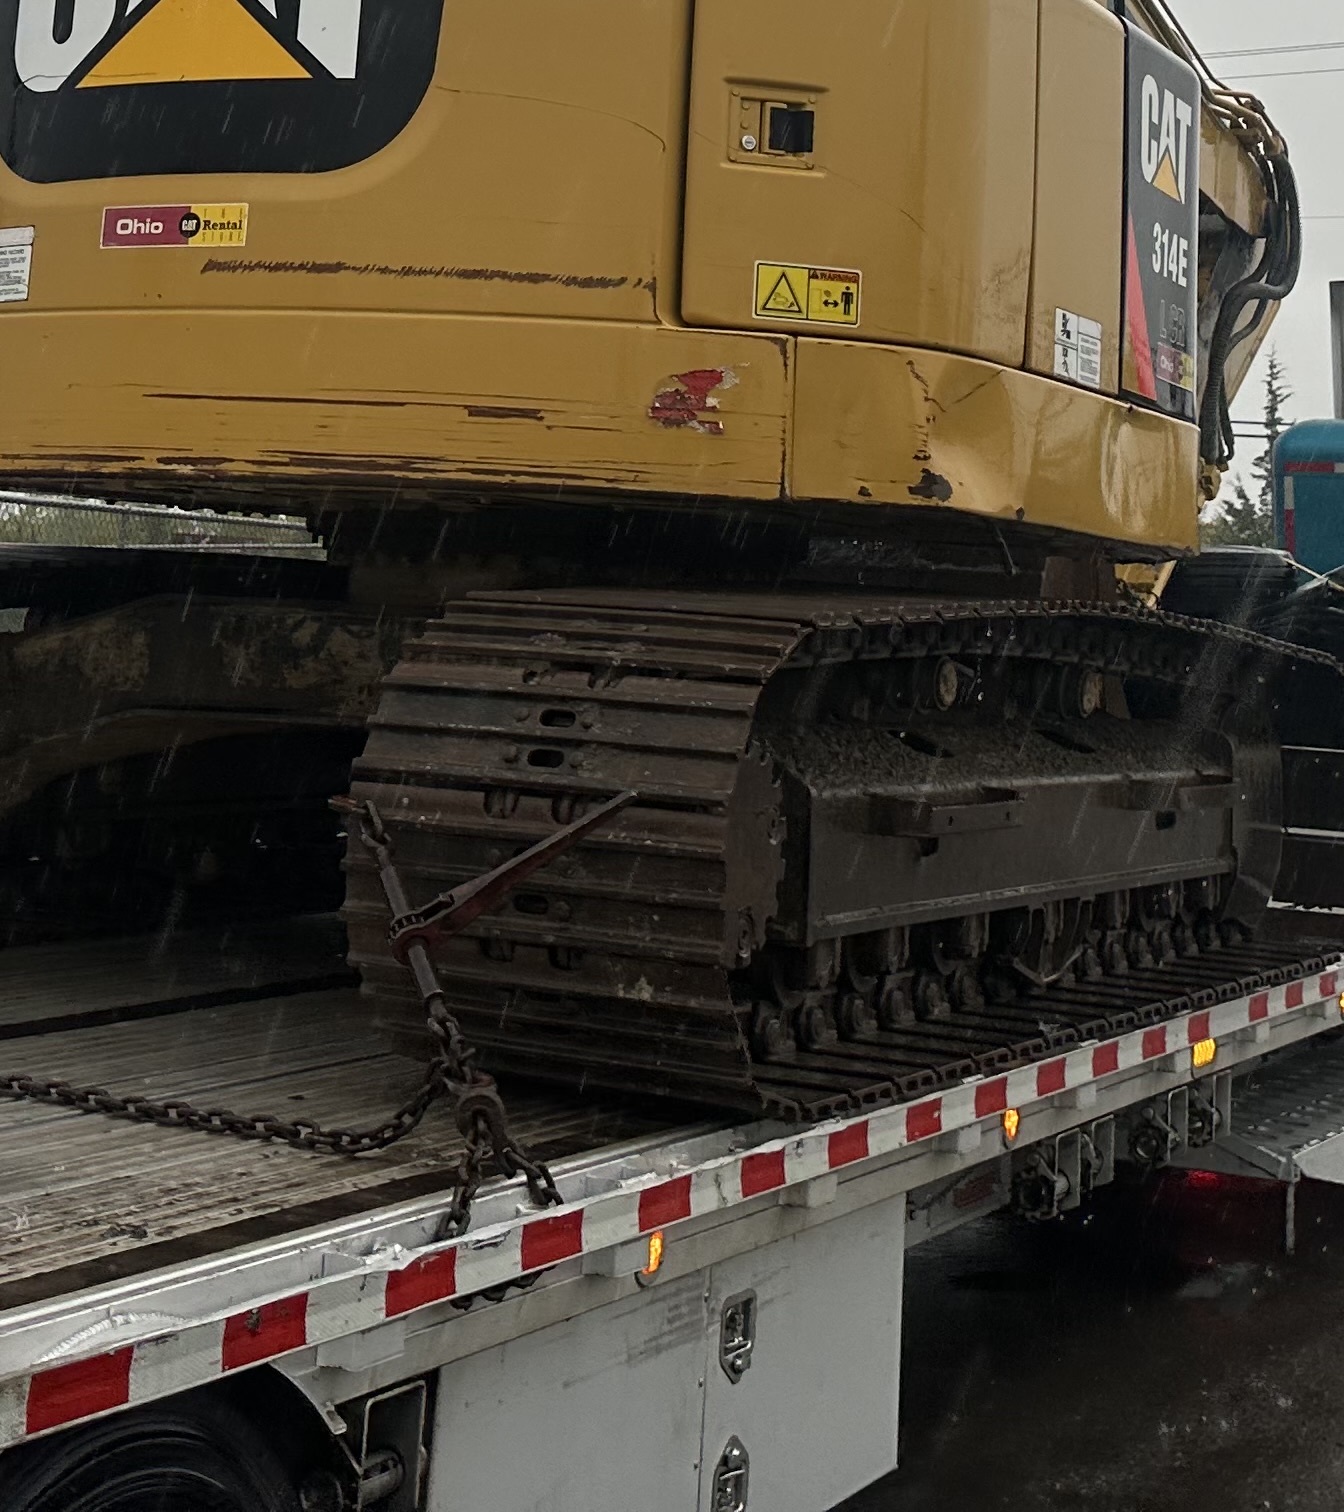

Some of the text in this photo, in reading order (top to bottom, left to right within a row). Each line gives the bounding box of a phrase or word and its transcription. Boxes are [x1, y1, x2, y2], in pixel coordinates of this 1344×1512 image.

[1141, 74, 1192, 204] CAT
[116, 217, 164, 235] Ohio
[181, 219, 244, 231] CAT Rental
[1152, 222, 1189, 288] 314E
